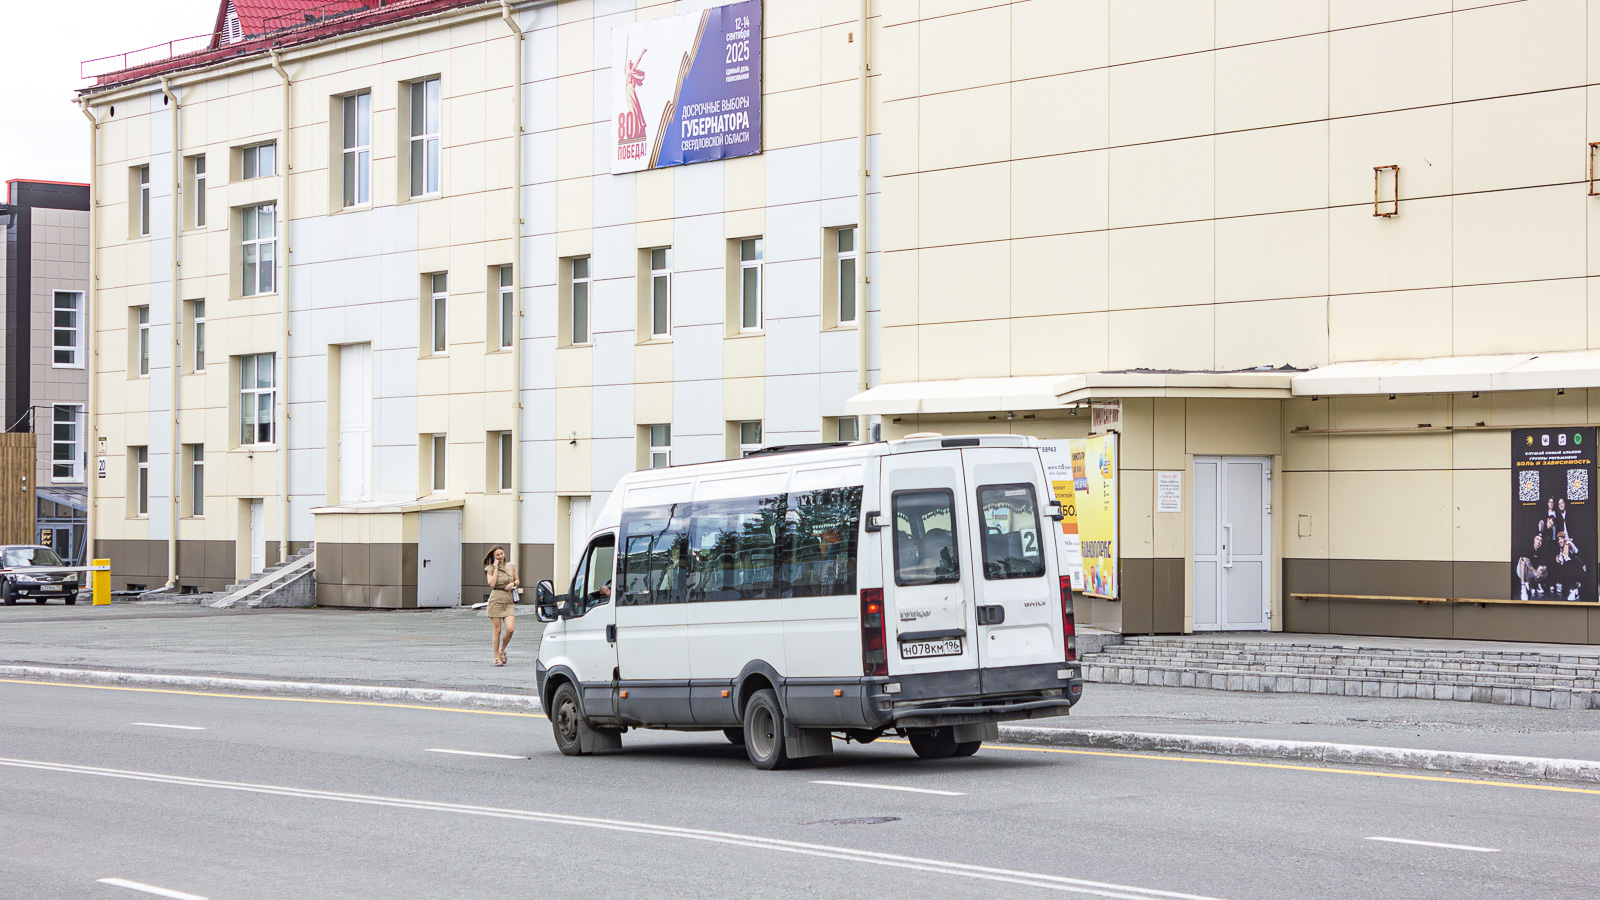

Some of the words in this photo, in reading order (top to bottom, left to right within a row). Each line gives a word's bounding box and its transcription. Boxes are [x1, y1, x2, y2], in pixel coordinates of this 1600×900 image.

[734, 15, 750, 31] 12-14
[726, 28, 750, 42] сентября
[726, 40, 750, 64] 2025
[682, 101, 720, 120] ДОСРОЧНЫЕ
[721, 95, 750, 112] ВЫБОРЫ
[618, 112, 635, 140] 80
[681, 111, 750, 138] ГУБЕРНАТОРА
[617, 142, 647, 160] ПОБЕДА!
[681, 134, 723, 152] СВЕРДЛОВСКОЙ
[724, 131, 750, 146] ОБЛАСТИ
[99, 459, 106, 471] 20
[1023, 531, 1038, 553] 2
[900, 608, 931, 619] IVECO
[905, 643, 944, 656] Н078КМ
[944, 640, 958, 651] 196
